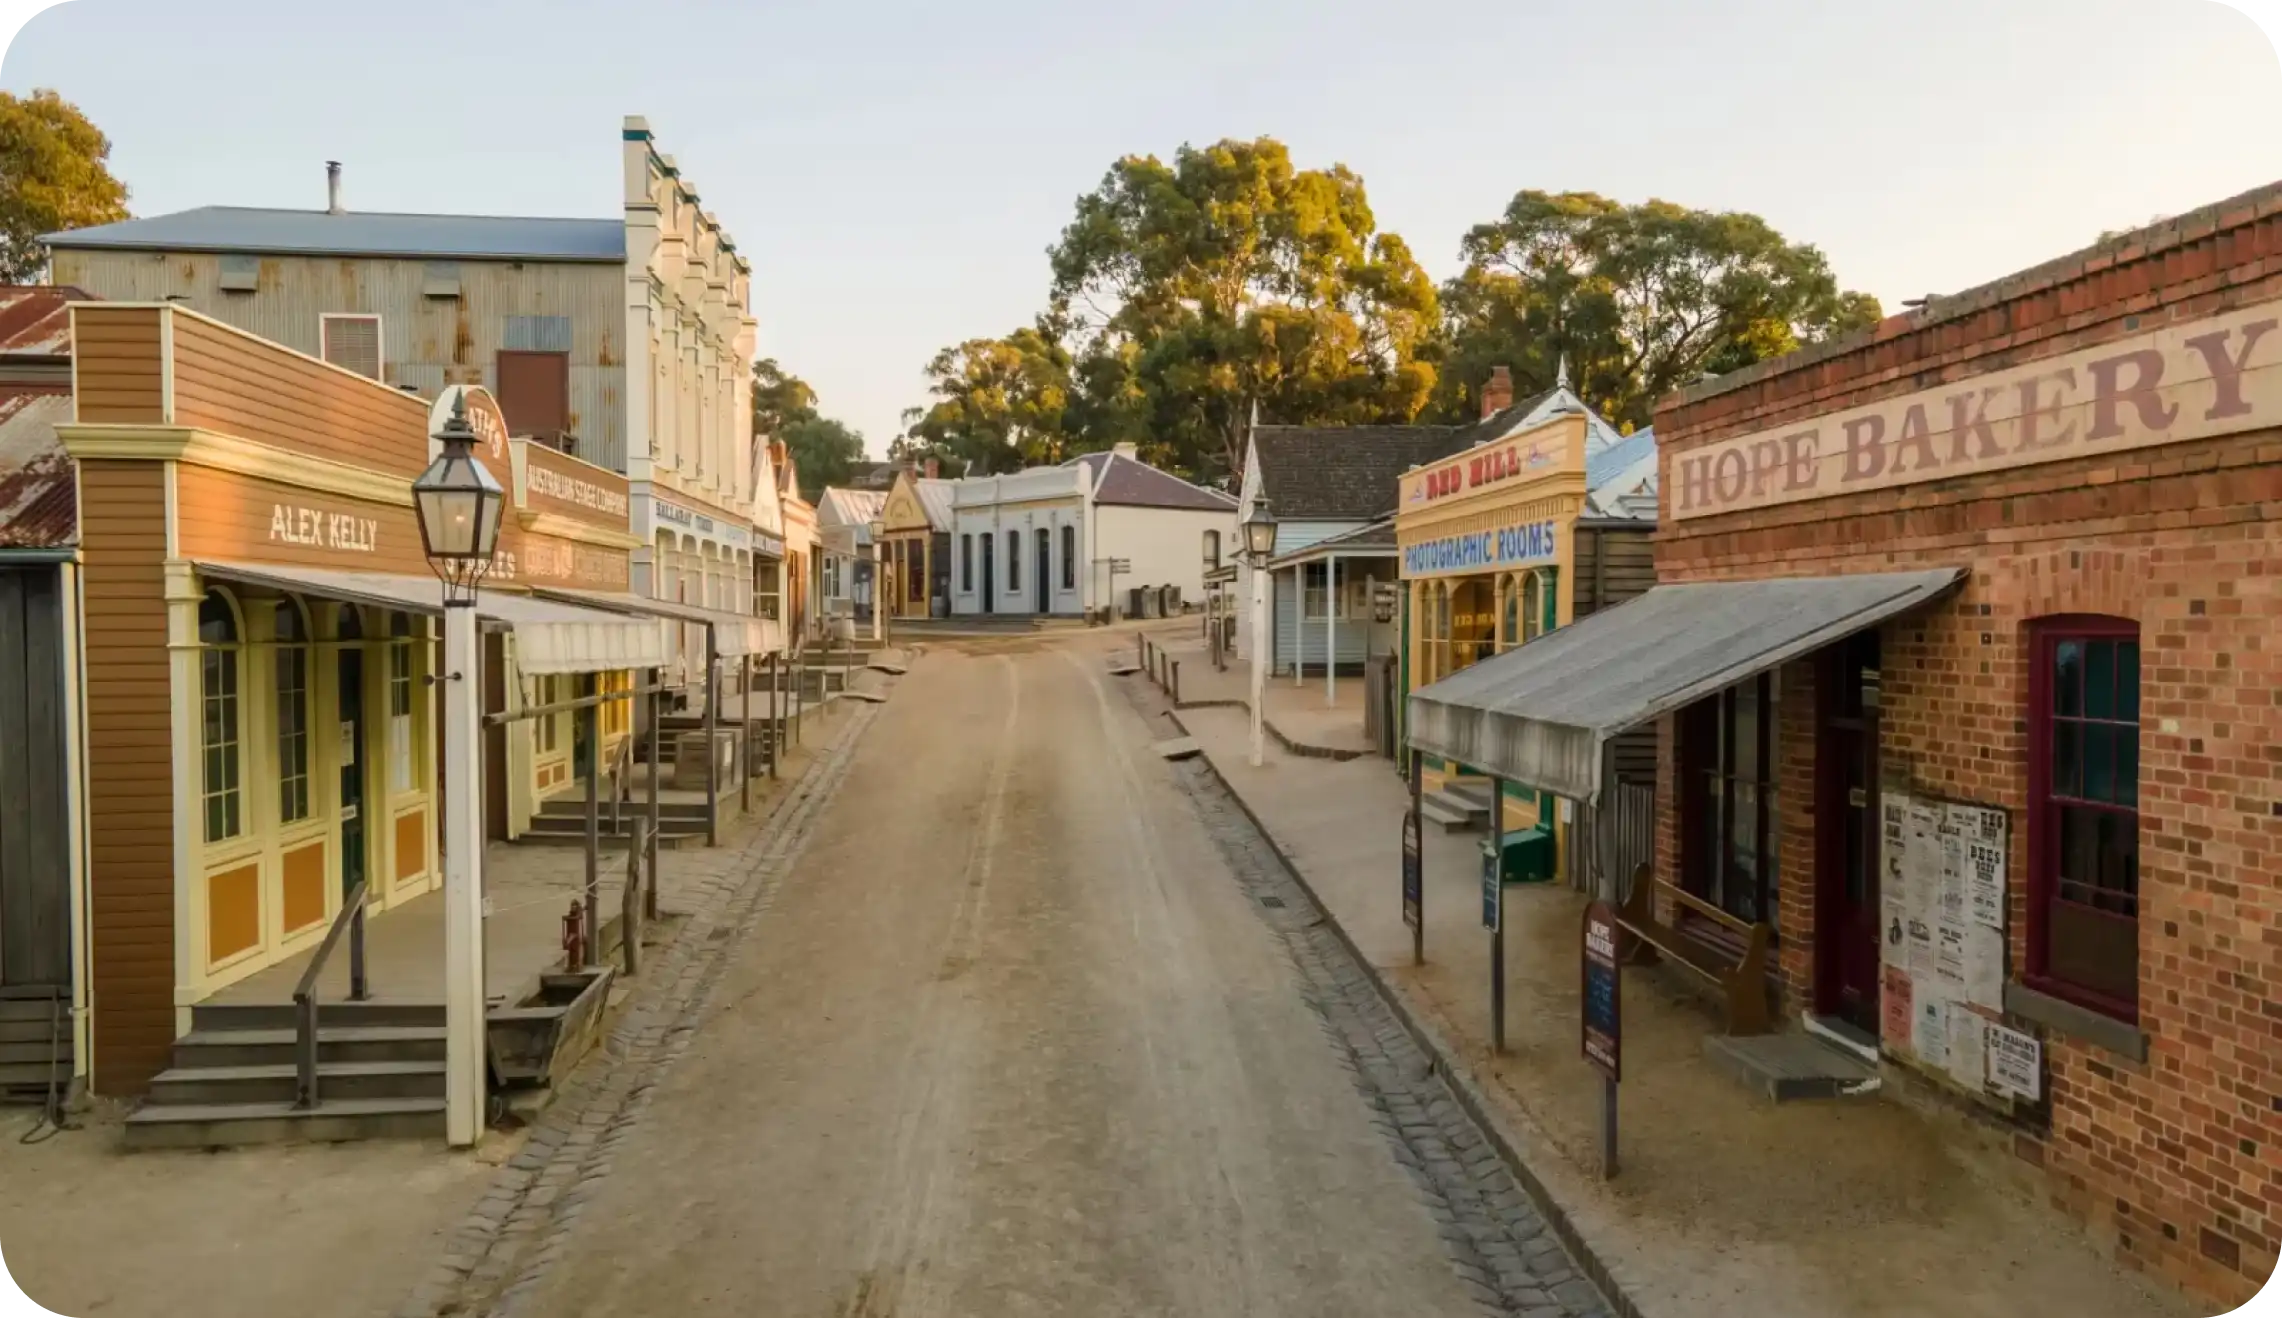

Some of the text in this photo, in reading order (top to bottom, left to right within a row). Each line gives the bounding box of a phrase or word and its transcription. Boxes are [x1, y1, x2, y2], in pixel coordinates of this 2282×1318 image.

[1678, 318, 2280, 512] HOPE BAKERY
[1426, 446, 1520, 500] RED HILL
[269, 504, 377, 551] ALEX KELLY
[1405, 520, 1554, 571] PHOTOGRAPHIC ROOMS
